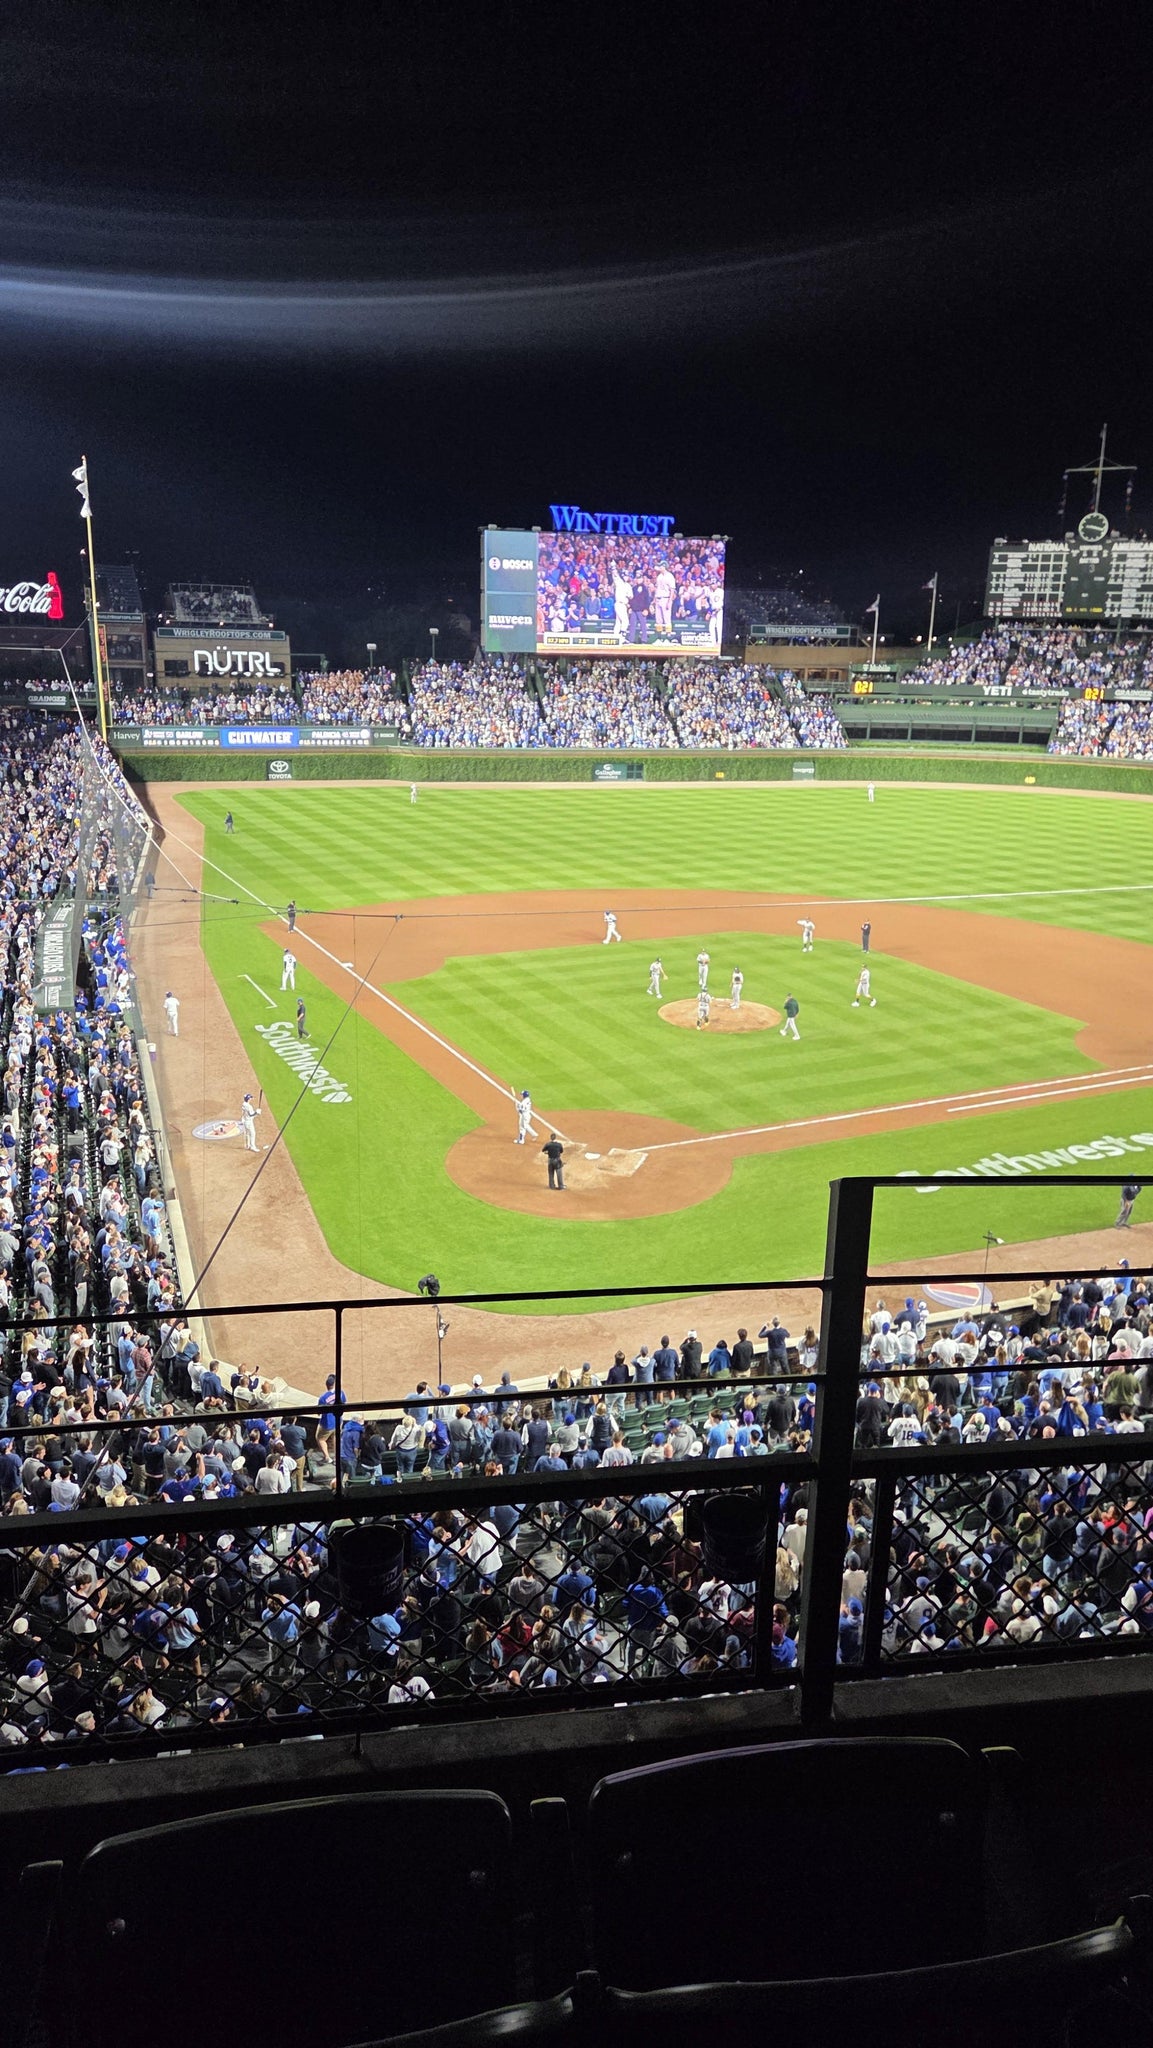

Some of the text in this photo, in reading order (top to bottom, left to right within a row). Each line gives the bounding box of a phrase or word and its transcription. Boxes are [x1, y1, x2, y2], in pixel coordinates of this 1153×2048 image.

[549, 505, 675, 536] WINTRUST
[1028, 543, 1069, 551] NATIONAL
[502, 559, 534, 570] BOSCH
[488, 614, 533, 625] nuveen
[193, 645, 281, 673] NÜTRL
[982, 686, 1012, 696] YETI
[113, 732, 140, 740] Harvey
[228, 731, 293, 744] CUTWATER
[254, 1021, 349, 1095] Southwest
[901, 1430, 914, 1441] 18
